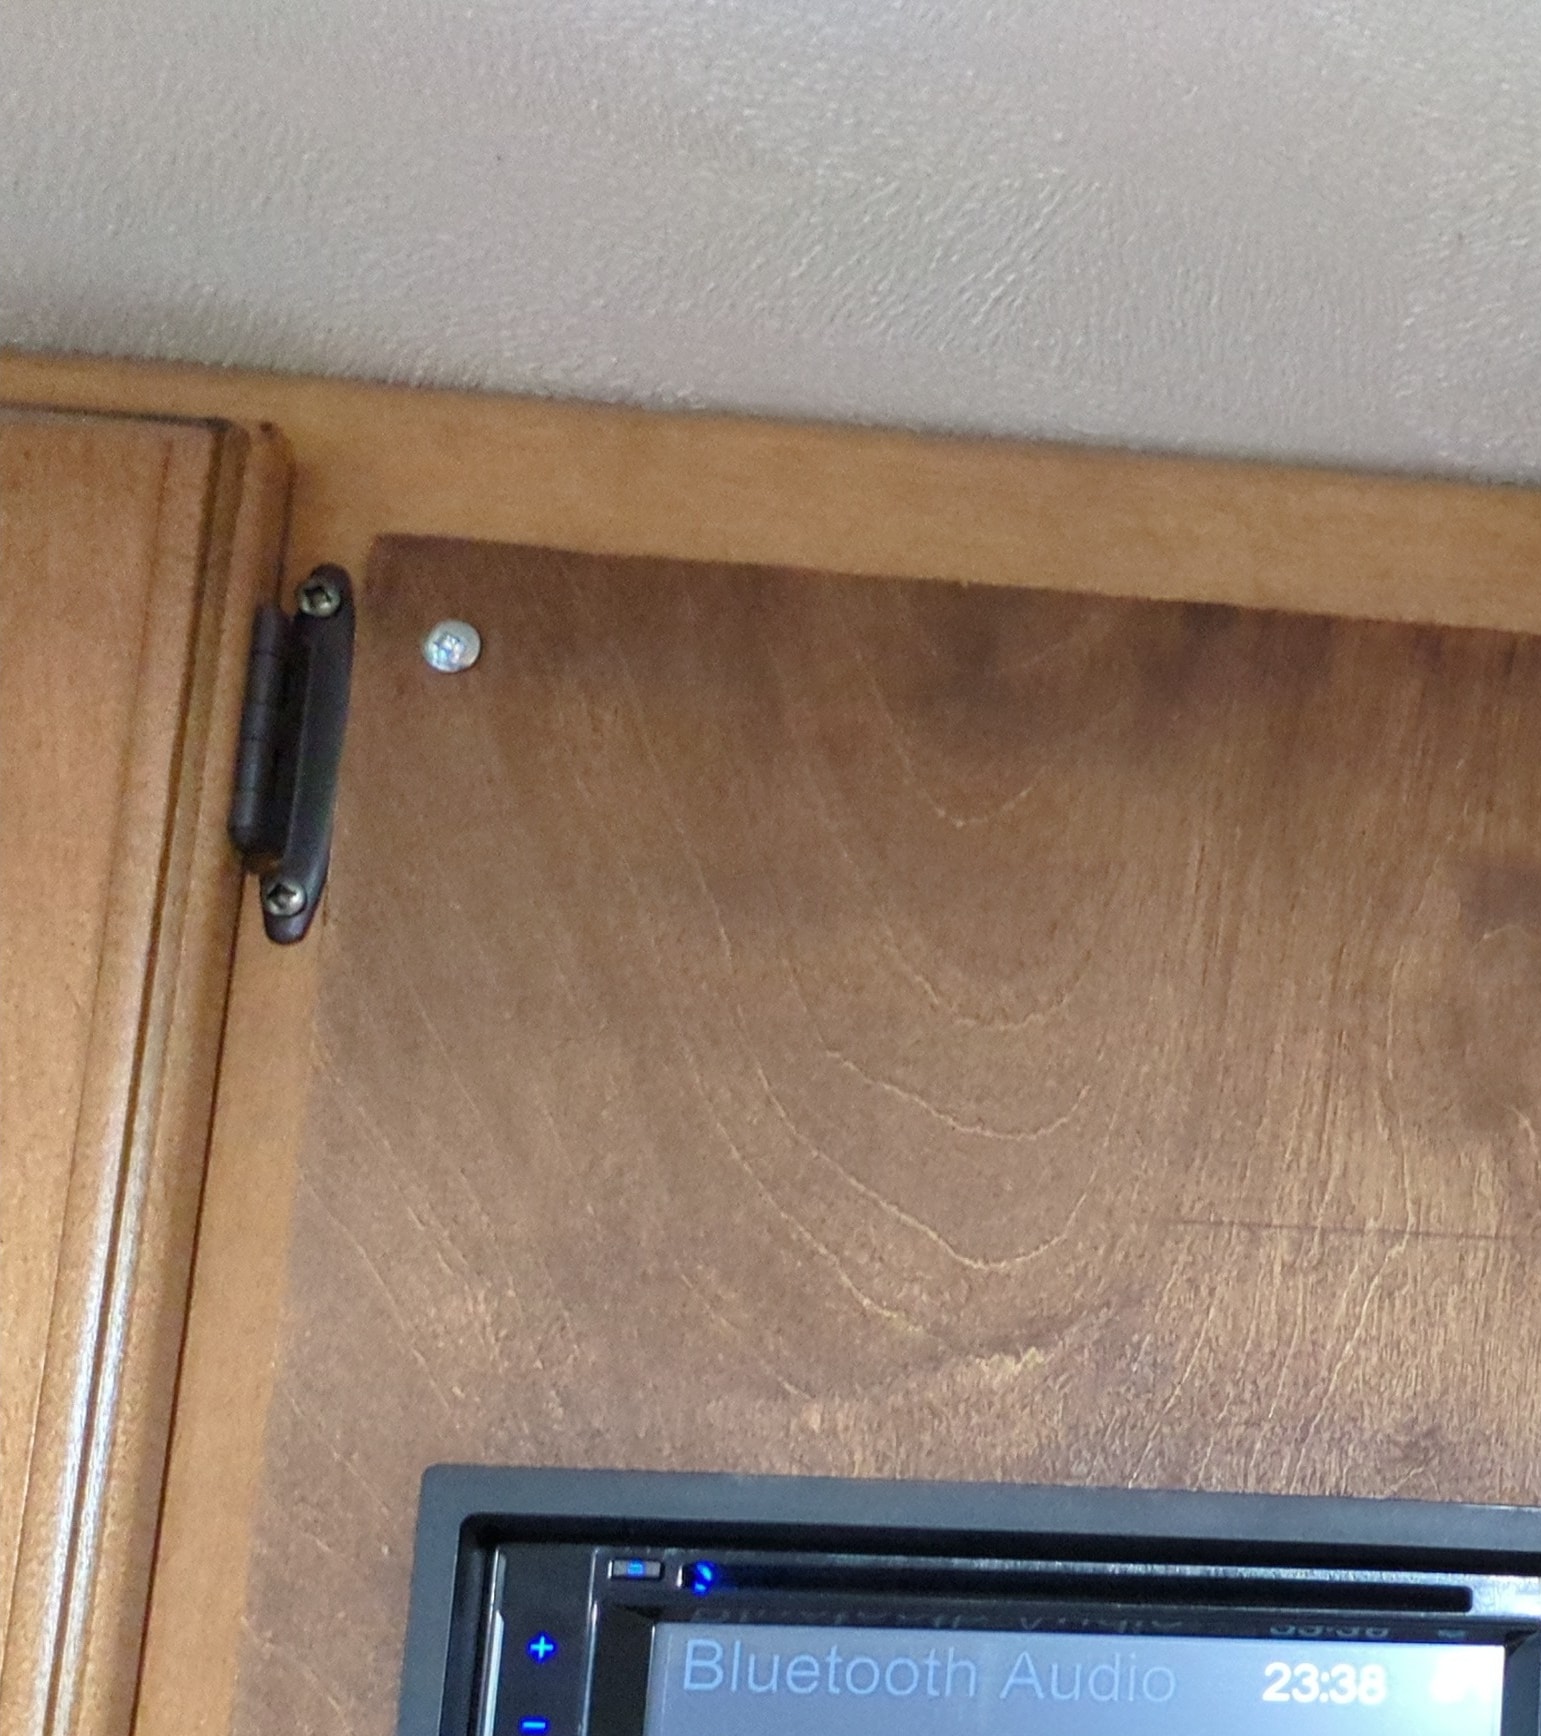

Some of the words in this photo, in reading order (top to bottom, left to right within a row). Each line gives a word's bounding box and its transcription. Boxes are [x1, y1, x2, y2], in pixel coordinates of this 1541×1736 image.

[683, 1639, 977, 1698] Bluetooth
[1000, 1652, 1177, 1703] Audio
[1263, 1663, 1388, 1704] 23:38
